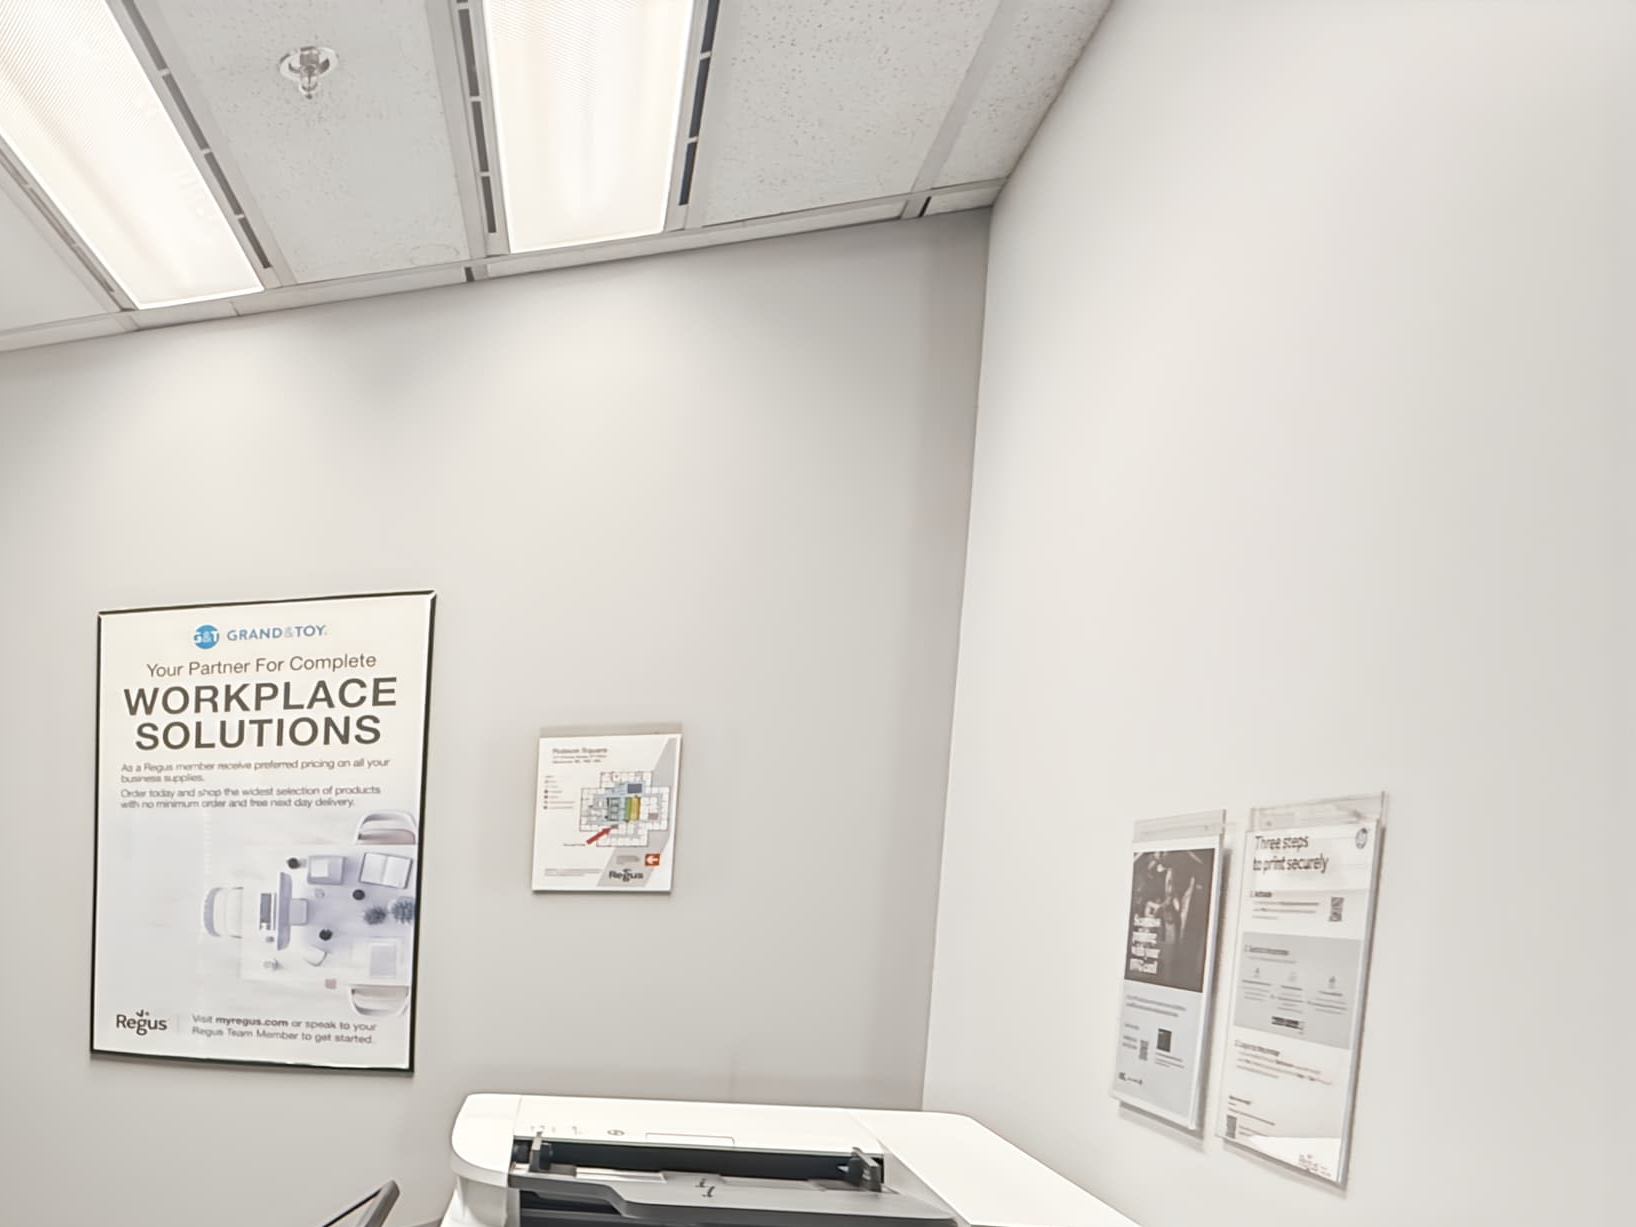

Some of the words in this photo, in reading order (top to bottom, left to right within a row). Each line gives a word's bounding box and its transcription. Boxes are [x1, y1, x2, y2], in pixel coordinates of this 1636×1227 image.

[146, 663, 184, 678] Your
[189, 660, 251, 676] Partner
[256, 657, 284, 673] For
[289, 653, 377, 673] Complete
[124, 677, 398, 716] WORKPLACE
[135, 715, 382, 751] SOLUTIONS
[176, 762, 214, 771] member
[218, 762, 252, 770] receive
[254, 760, 299, 771] preferred
[301, 760, 335, 770] pricing
[353, 758, 365, 767] all
[367, 759, 390, 769] your
[121, 775, 162, 783] business
[121, 789, 146, 798] Order
[149, 789, 175, 799] today
[177, 788, 195, 797] and
[198, 788, 221, 798] shop
[224, 788, 239, 796] the
[242, 787, 273, 796] widest
[276, 787, 320, 796] selection
[322, 786, 333, 795] of
[335, 786, 381, 796] products
[121, 800, 140, 808] with
[156, 800, 199, 808] minimum
[201, 799, 226, 808] order
[229, 799, 247, 808] and
[250, 799, 268, 807] free
[271, 799, 292, 808] next
[294, 799, 313, 808] day
[1283, 836, 1308, 852] steps
[1287, 853, 1329, 874] securely
[116, 1013, 168, 1036] Regus
[192, 1014, 213, 1023] Visit
[215, 1016, 289, 1027] myregus.com
[305, 1019, 336, 1030] speak
[339, 1021, 350, 1030] to
[353, 1023, 377, 1032] your
[192, 1026, 223, 1037] Regus
[227, 1027, 253, 1037] Team
[256, 1029, 299, 1040] Member
[301, 1031, 312, 1041] to
[315, 1033, 331, 1043] get
